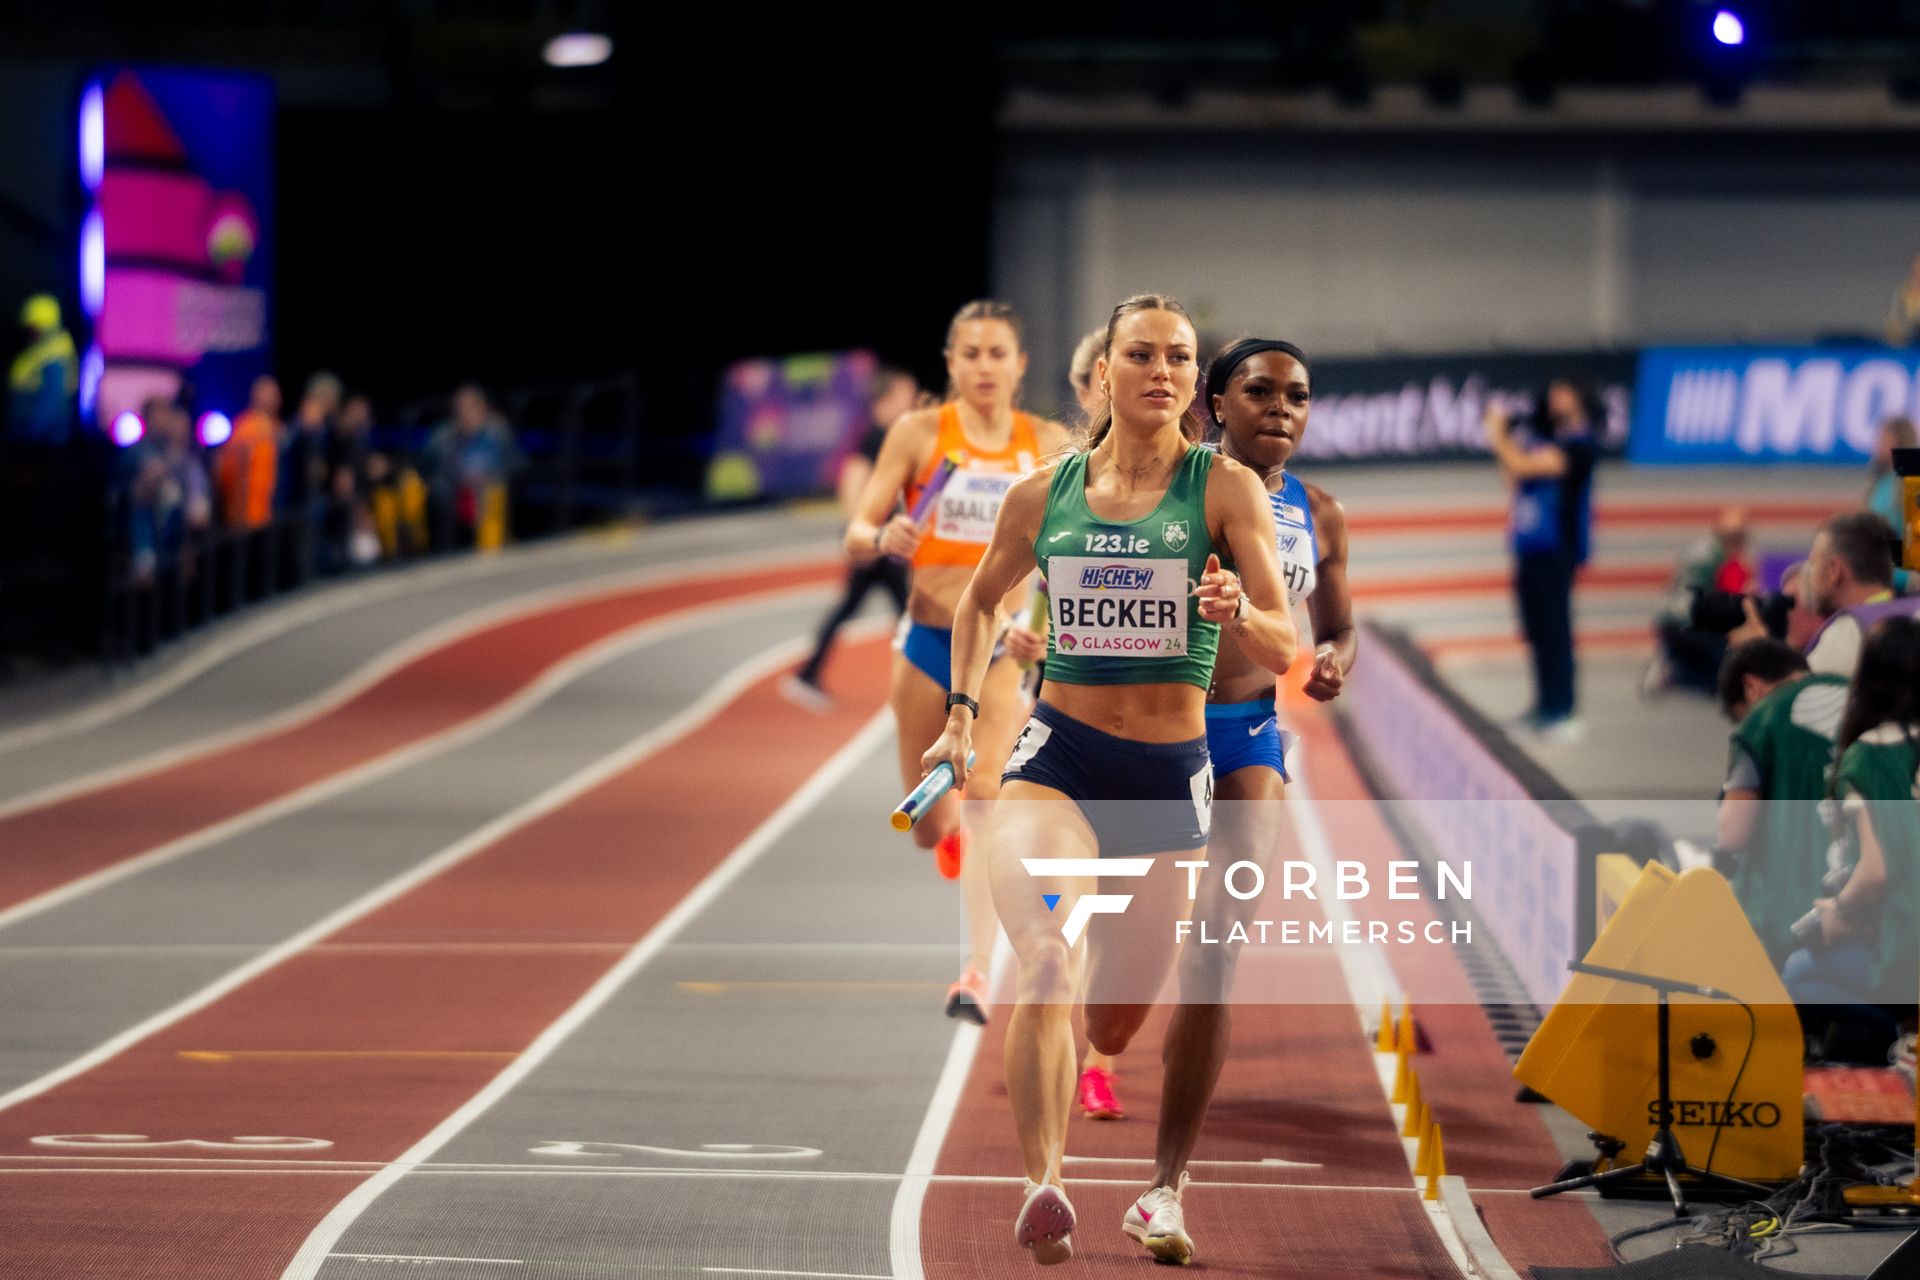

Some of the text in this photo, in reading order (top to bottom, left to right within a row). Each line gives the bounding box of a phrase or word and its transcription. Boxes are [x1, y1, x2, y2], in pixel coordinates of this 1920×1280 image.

[1085, 533, 1150, 554] 123.ie
[1079, 565, 1154, 590] HI-CHEW
[1059, 597, 1177, 629] BECKER
[1082, 636, 1182, 651] GLASGOW 24
[1648, 1099, 1781, 1128] SEIKO
